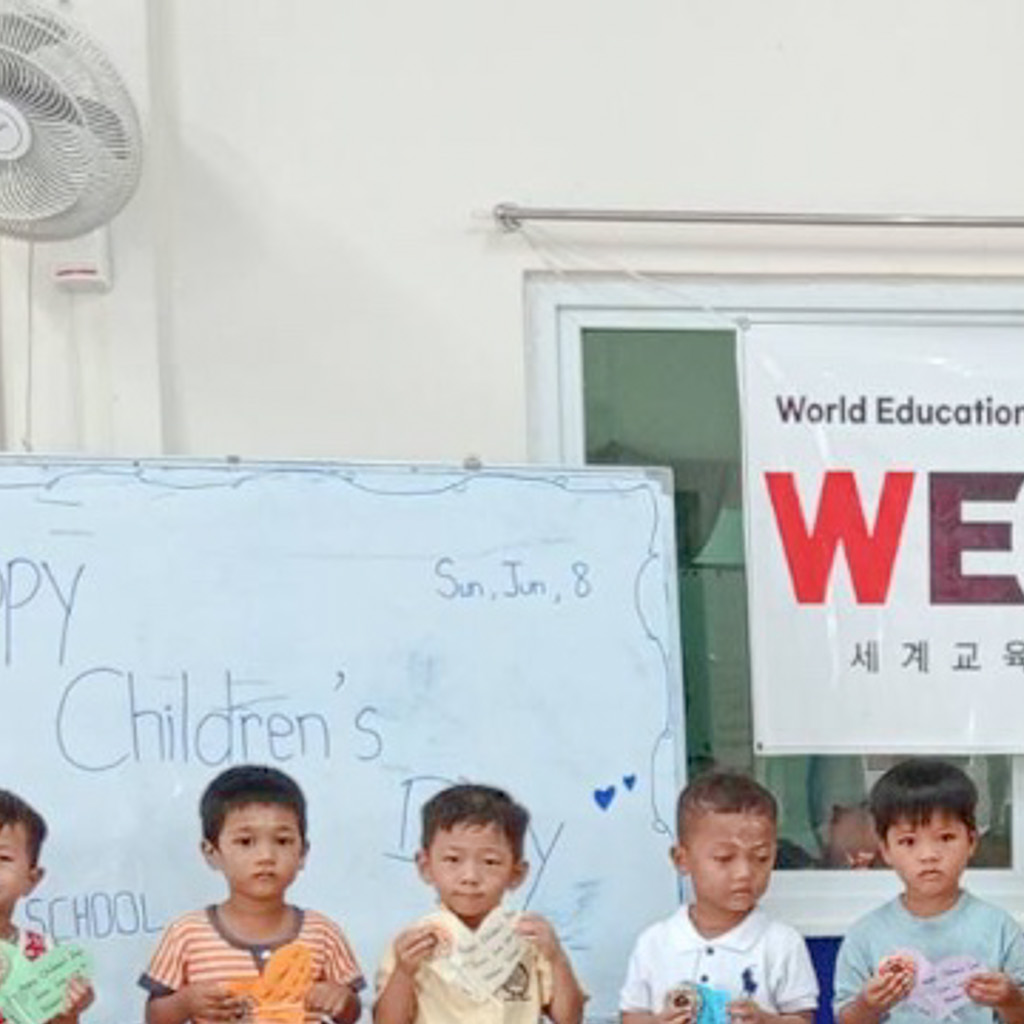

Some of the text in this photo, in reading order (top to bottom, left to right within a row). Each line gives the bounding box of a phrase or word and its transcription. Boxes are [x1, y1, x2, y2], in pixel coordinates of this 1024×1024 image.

[776, 396, 867, 424] World
[571, 561, 593, 598] 8
[56, 667, 384, 772] Children's
